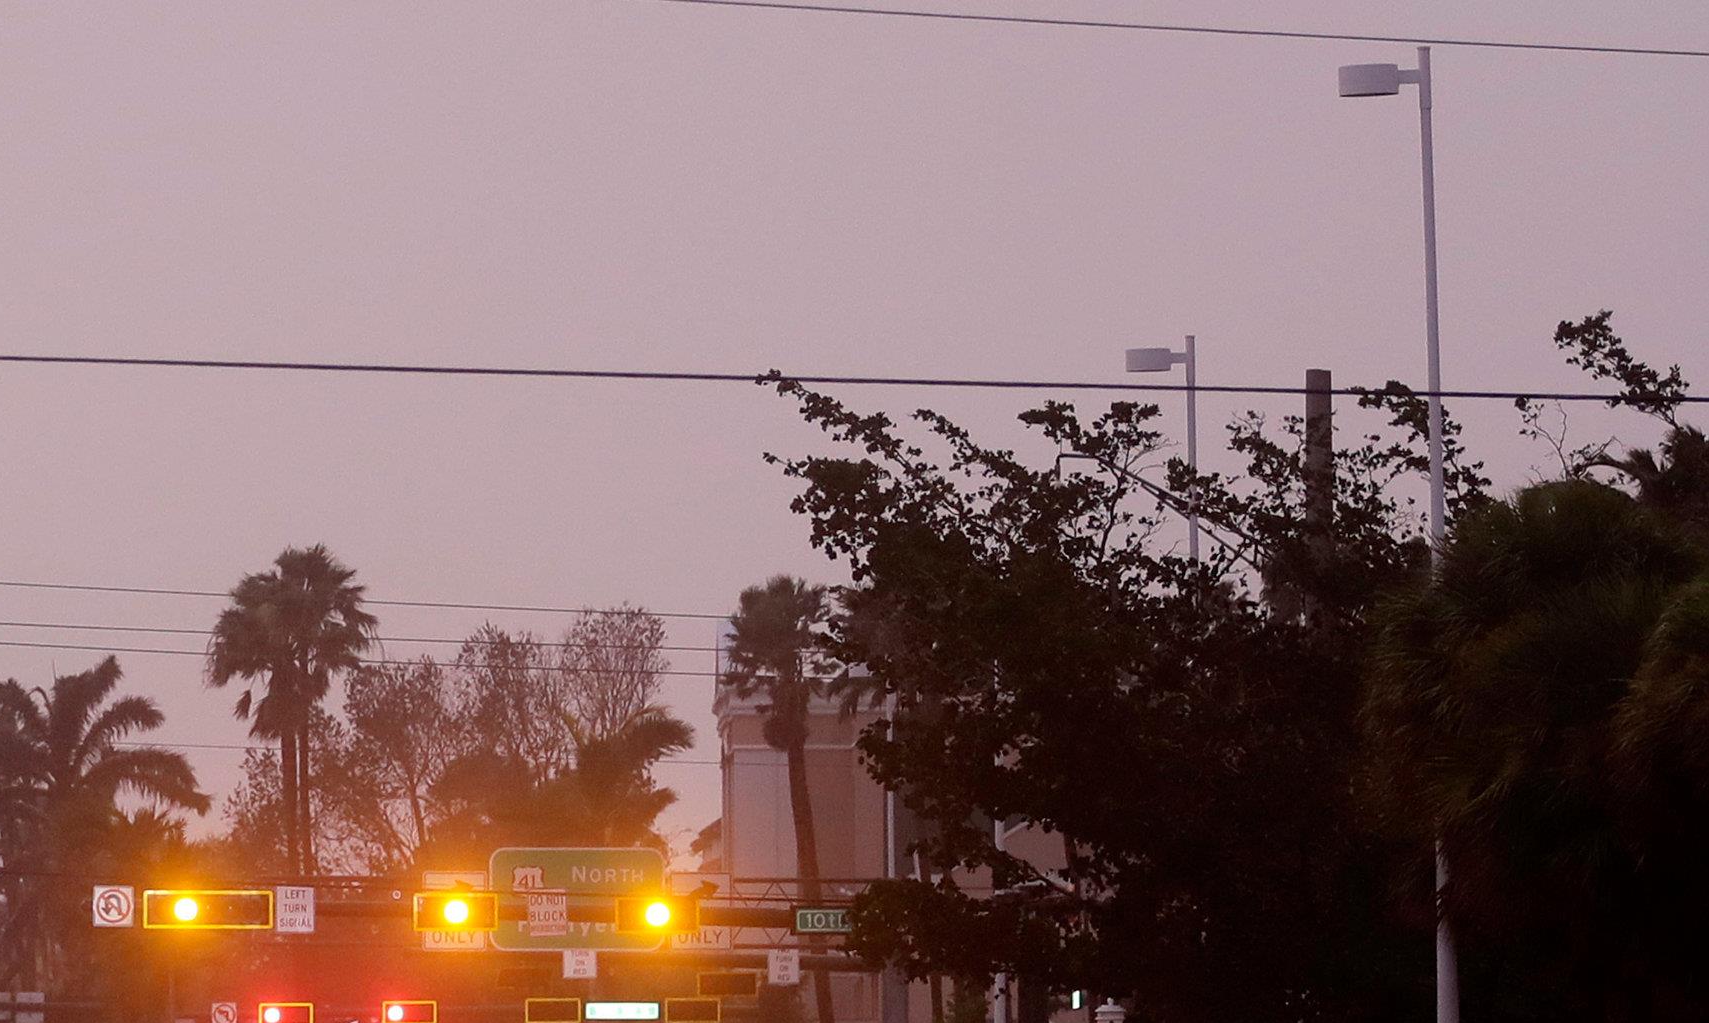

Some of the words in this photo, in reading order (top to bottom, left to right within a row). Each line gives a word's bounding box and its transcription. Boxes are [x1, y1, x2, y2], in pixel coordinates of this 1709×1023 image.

[571, 866, 644, 883] NORTH
[518, 874, 536, 889] 41
[284, 890, 306, 899] LEFT
[530, 895, 543, 906] DO
[546, 895, 564, 905] NOT
[283, 903, 307, 913] TURN
[530, 910, 566, 922] BLOCK
[279, 917, 312, 928] SIGNAL
[432, 931, 475, 944] ONLY
[678, 930, 723, 944] ONLY
